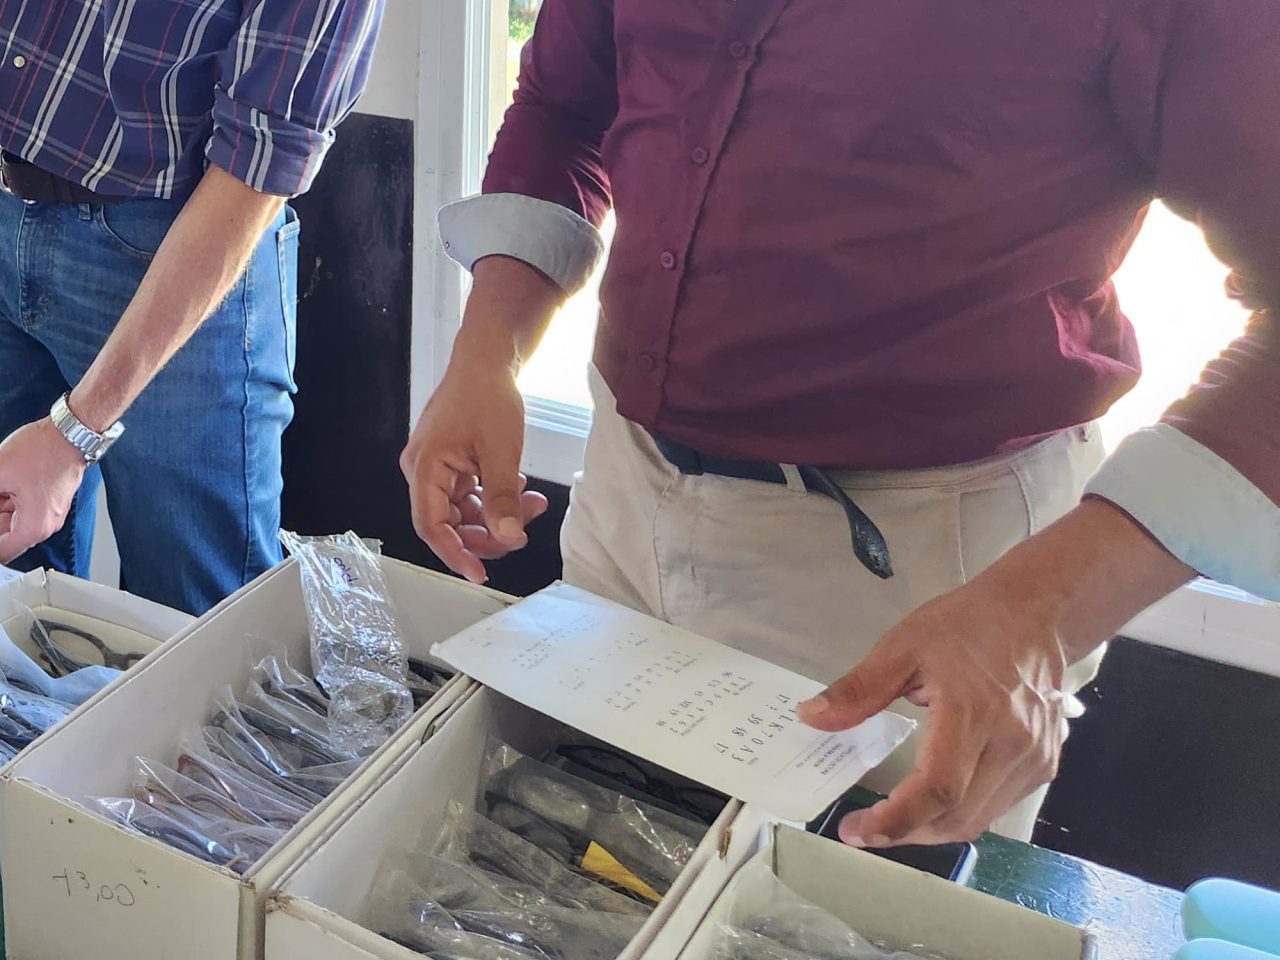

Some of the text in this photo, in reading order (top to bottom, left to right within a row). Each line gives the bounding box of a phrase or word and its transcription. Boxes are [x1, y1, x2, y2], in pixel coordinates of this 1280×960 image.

[747, 713, 764, 725] 39
[768, 721, 784, 732] K
[712, 742, 729, 754] 17
[739, 744, 754, 753] A
